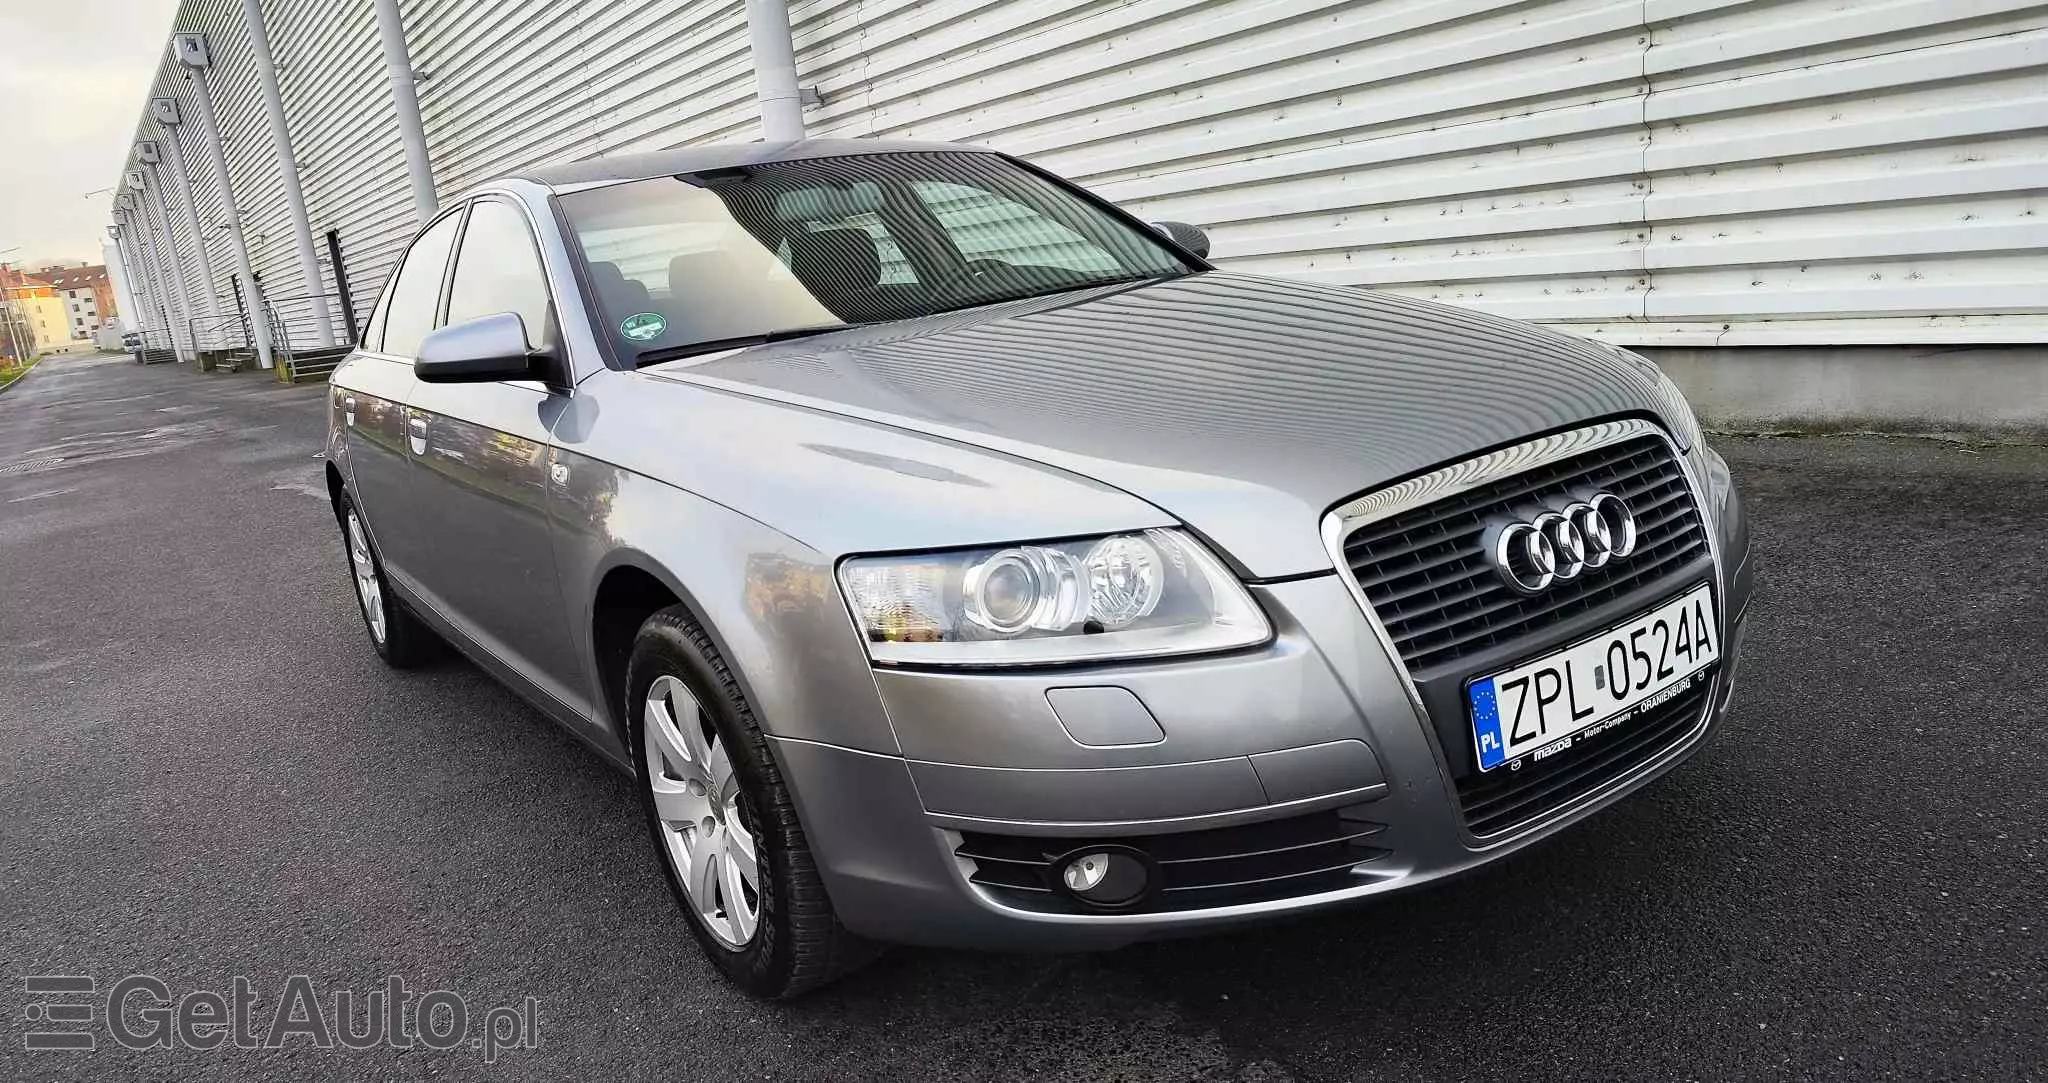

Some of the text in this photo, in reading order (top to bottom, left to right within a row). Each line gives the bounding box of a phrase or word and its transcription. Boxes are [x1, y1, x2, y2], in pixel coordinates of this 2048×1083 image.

[1502, 599, 1712, 748] ZPL 0524A
[1641, 679, 1691, 712] ORANIENBURG
[1481, 732, 1500, 752] PL
